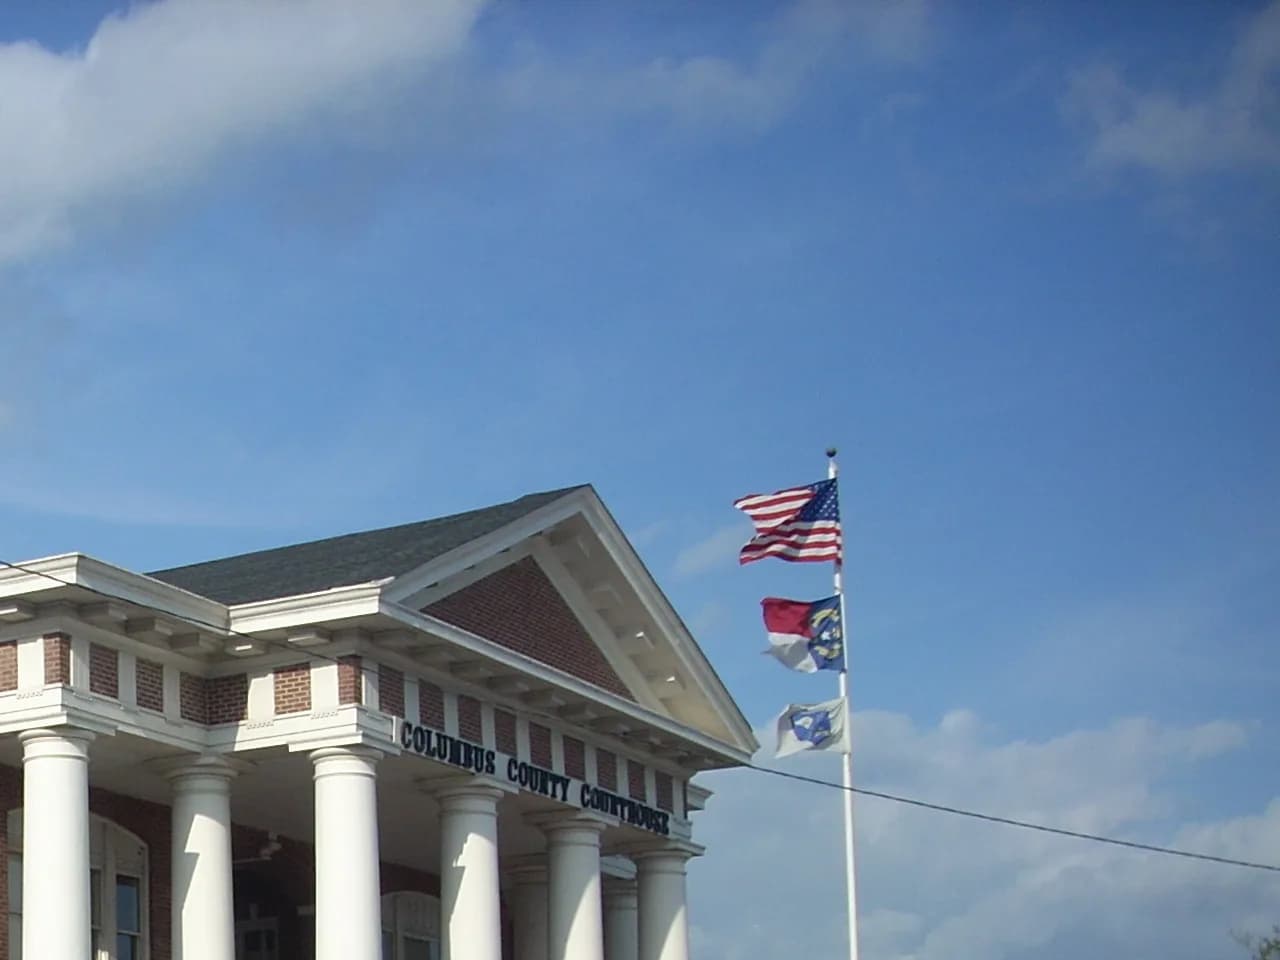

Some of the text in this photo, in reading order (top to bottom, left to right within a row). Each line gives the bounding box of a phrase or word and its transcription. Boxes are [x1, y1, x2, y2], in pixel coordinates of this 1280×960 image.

[401, 721, 670, 835] COLUMBUS COUNTY COURTHOUSE
